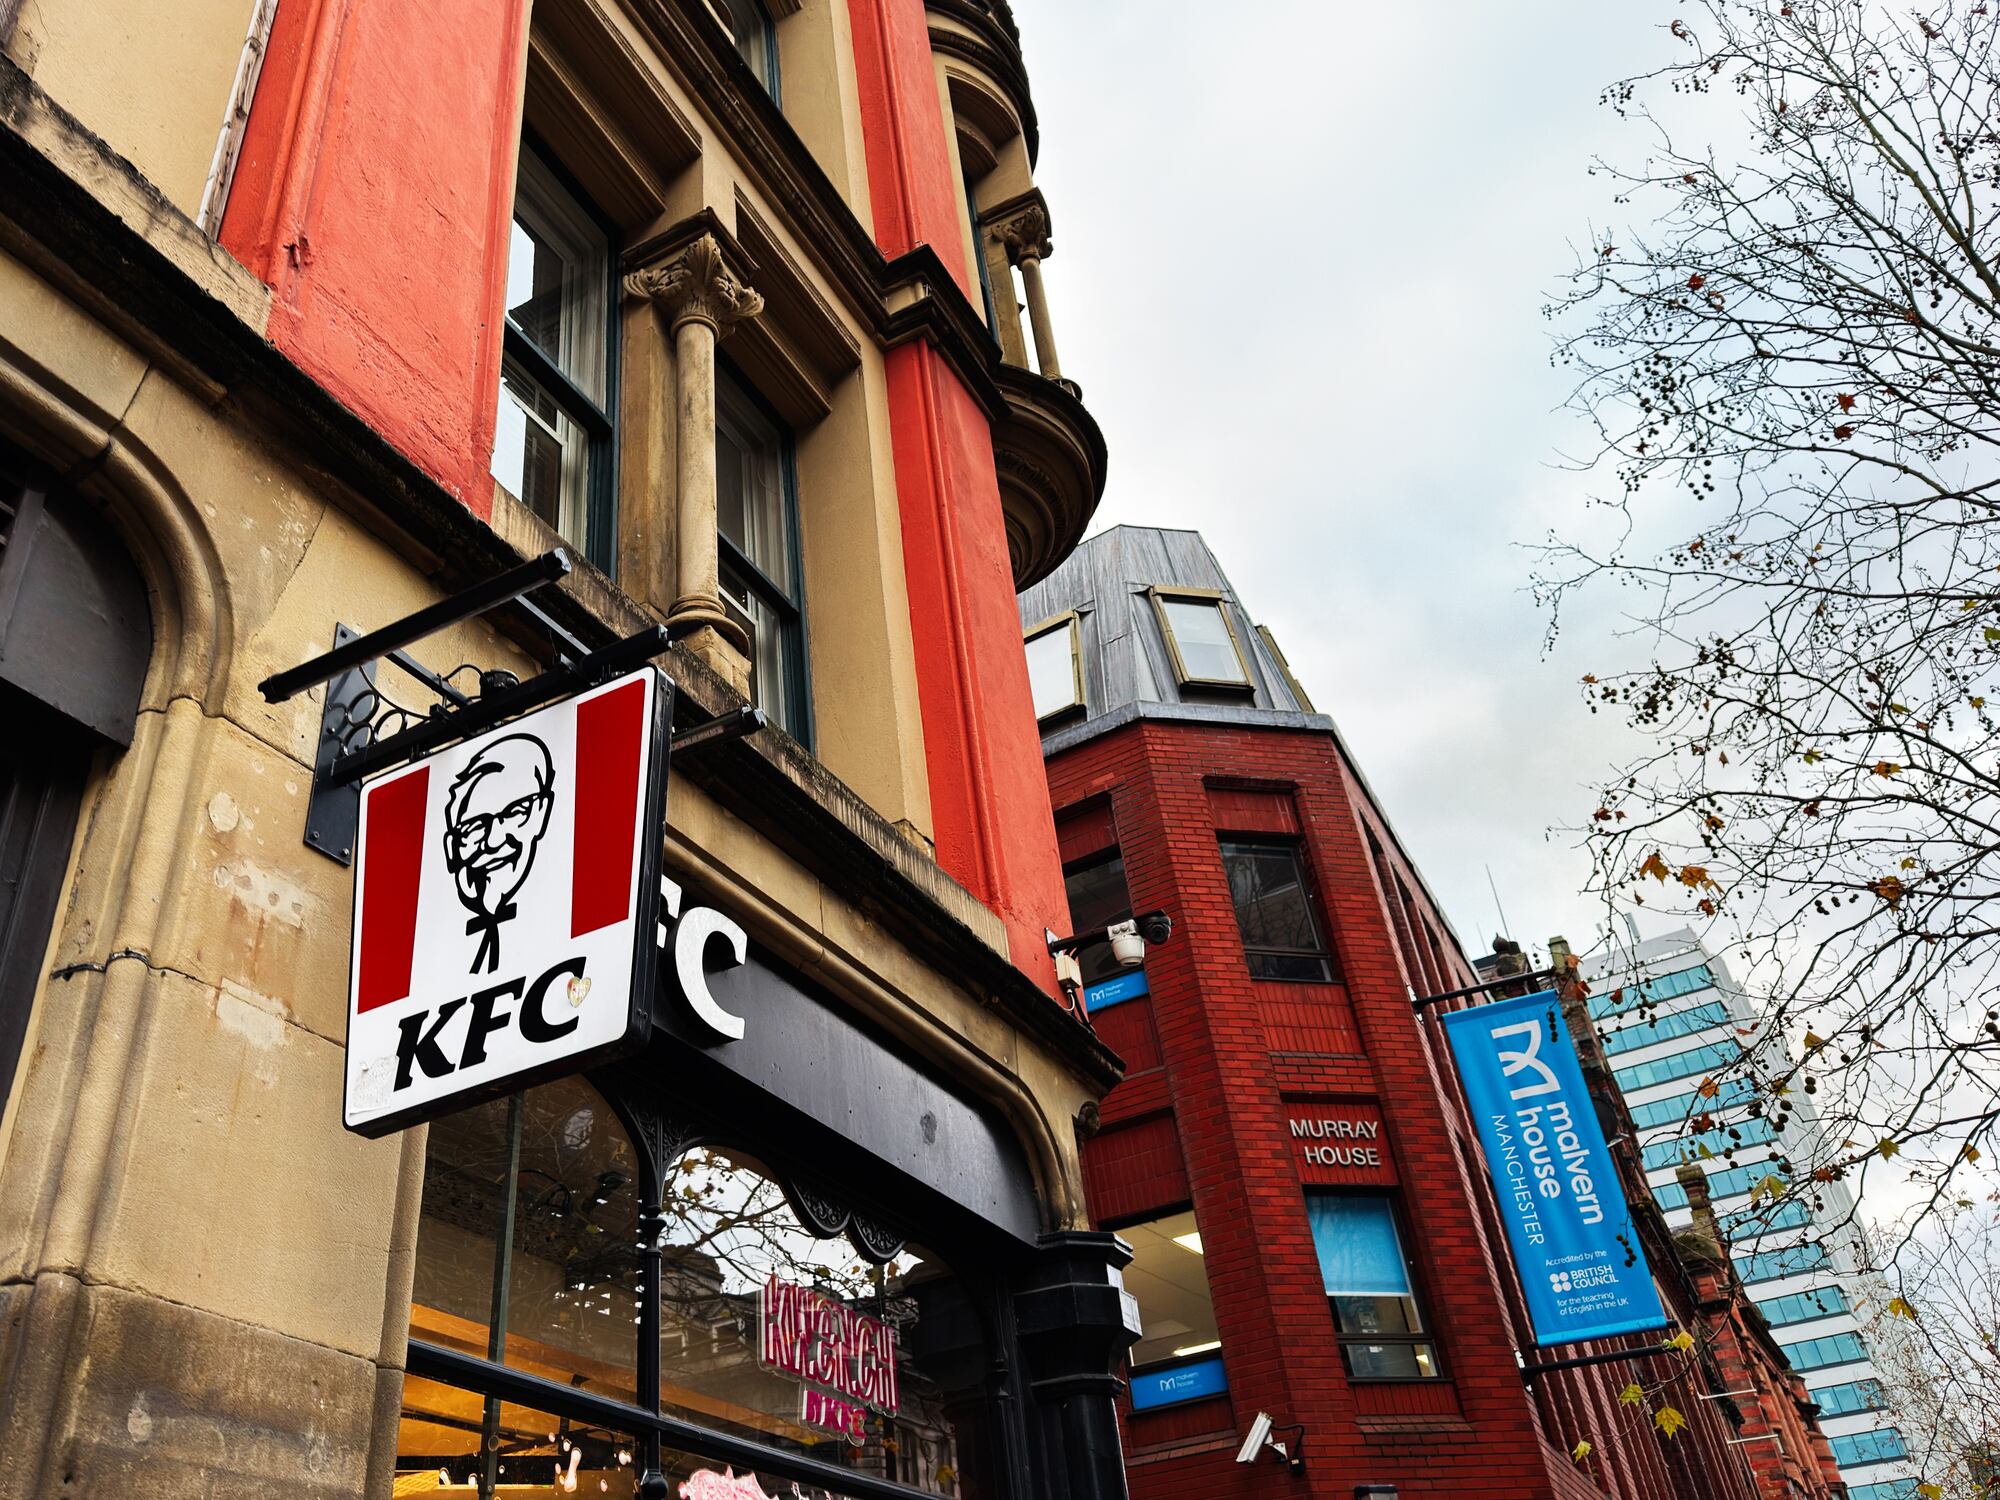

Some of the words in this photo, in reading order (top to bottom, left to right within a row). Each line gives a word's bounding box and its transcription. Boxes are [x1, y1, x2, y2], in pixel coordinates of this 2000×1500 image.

[393, 956, 587, 1092] KFC
[1289, 1119, 1378, 1138] MURRAY
[1304, 1146, 1381, 1166] HOUSE
[1516, 1106, 1561, 1199] house
[1546, 1101, 1604, 1225] malvern
[1491, 1114, 1545, 1245] MANCHESTER
[1545, 1254, 1584, 1267] Accredited
[1584, 1252, 1594, 1260] by
[1570, 1264, 1613, 1280] BRITISH
[1573, 1274, 1619, 1289] COUNCIL
[1557, 1299, 1568, 1307] for
[1568, 1297, 1581, 1305] the
[1582, 1292, 1614, 1303] teaching
[1559, 1308, 1568, 1316] of
[1568, 1303, 1595, 1315] English
[1604, 1300, 1616, 1308] the
[1617, 1297, 1629, 1307] UK
